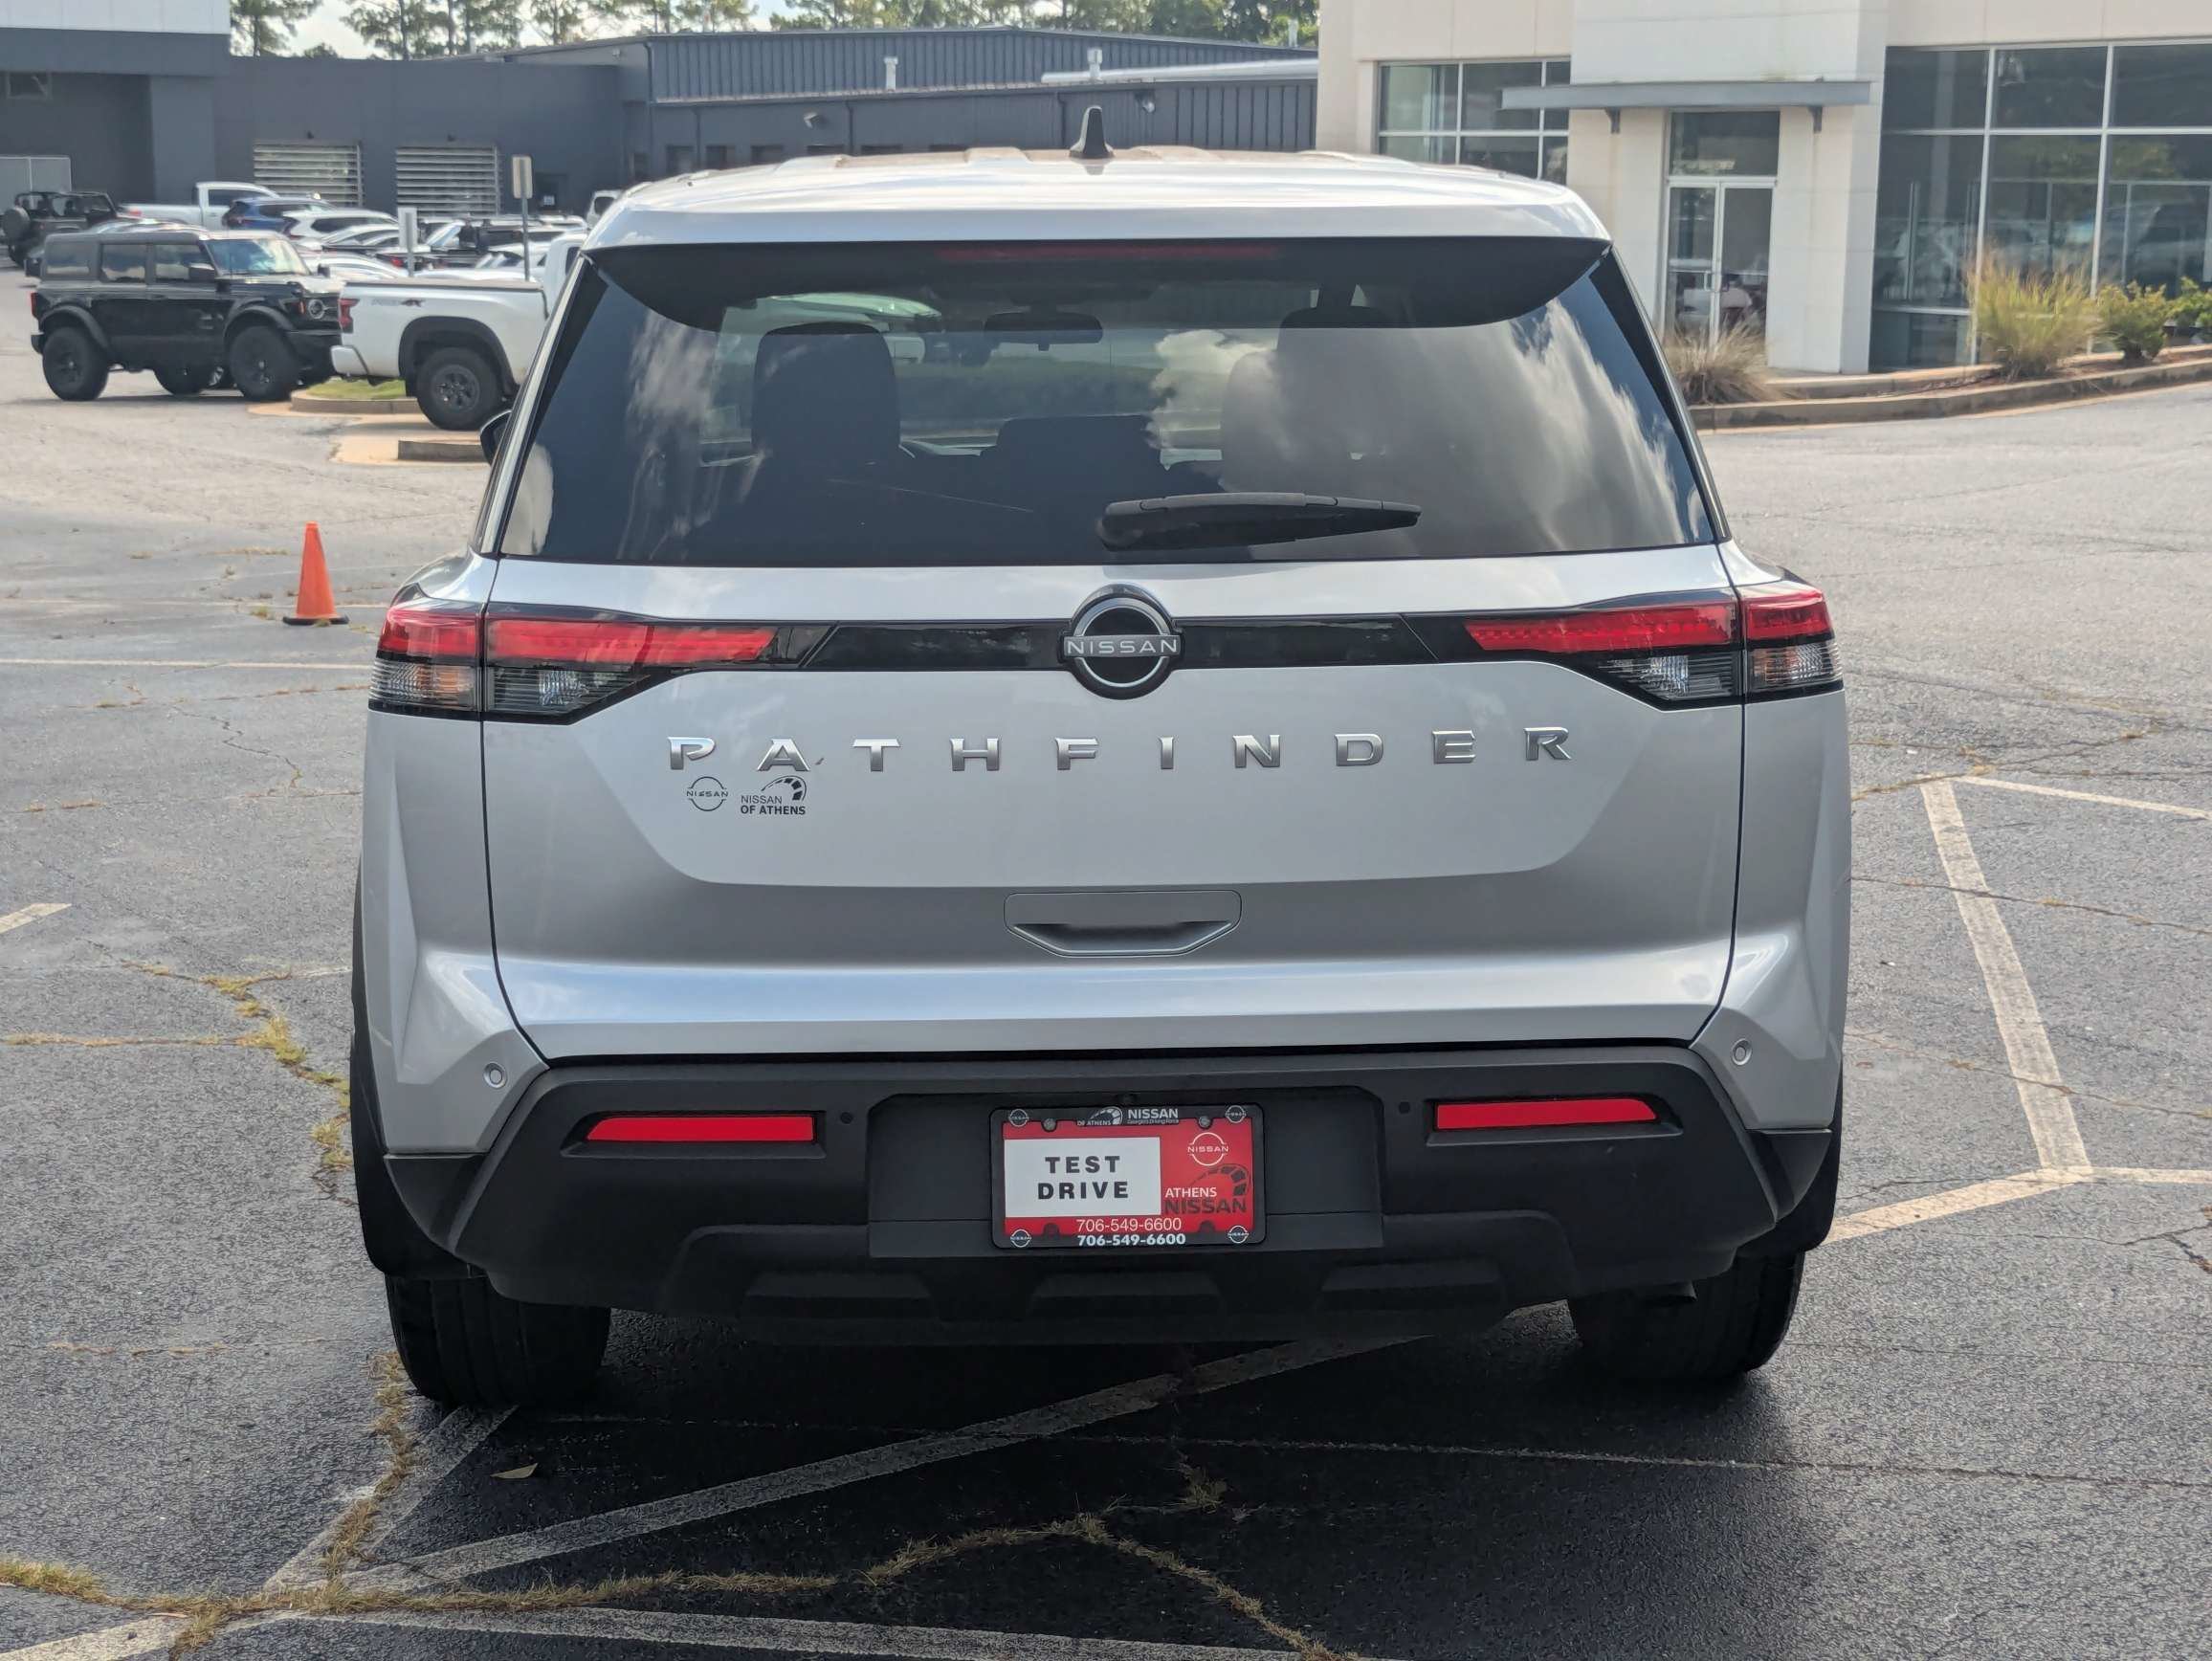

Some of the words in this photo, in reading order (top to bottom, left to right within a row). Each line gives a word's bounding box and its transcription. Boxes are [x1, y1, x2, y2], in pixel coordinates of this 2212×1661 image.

[1067, 638, 1179, 656] NISSAN
[667, 726, 1571, 772] PATHFINDER
[741, 795, 783, 805] NISSAN
[741, 805, 756, 815] OF
[759, 805, 806, 815] ATHENS
[1127, 1108, 1179, 1119] NISSAN
[1044, 1155, 1121, 1174] TEST
[1037, 1181, 1129, 1200] DRIVE
[1164, 1186, 1218, 1198] ATHENS
[1163, 1198, 1248, 1214] NISSAN
[1076, 1217, 1183, 1231] 706-549-6600
[1077, 1232, 1186, 1246] 706-549-6600
